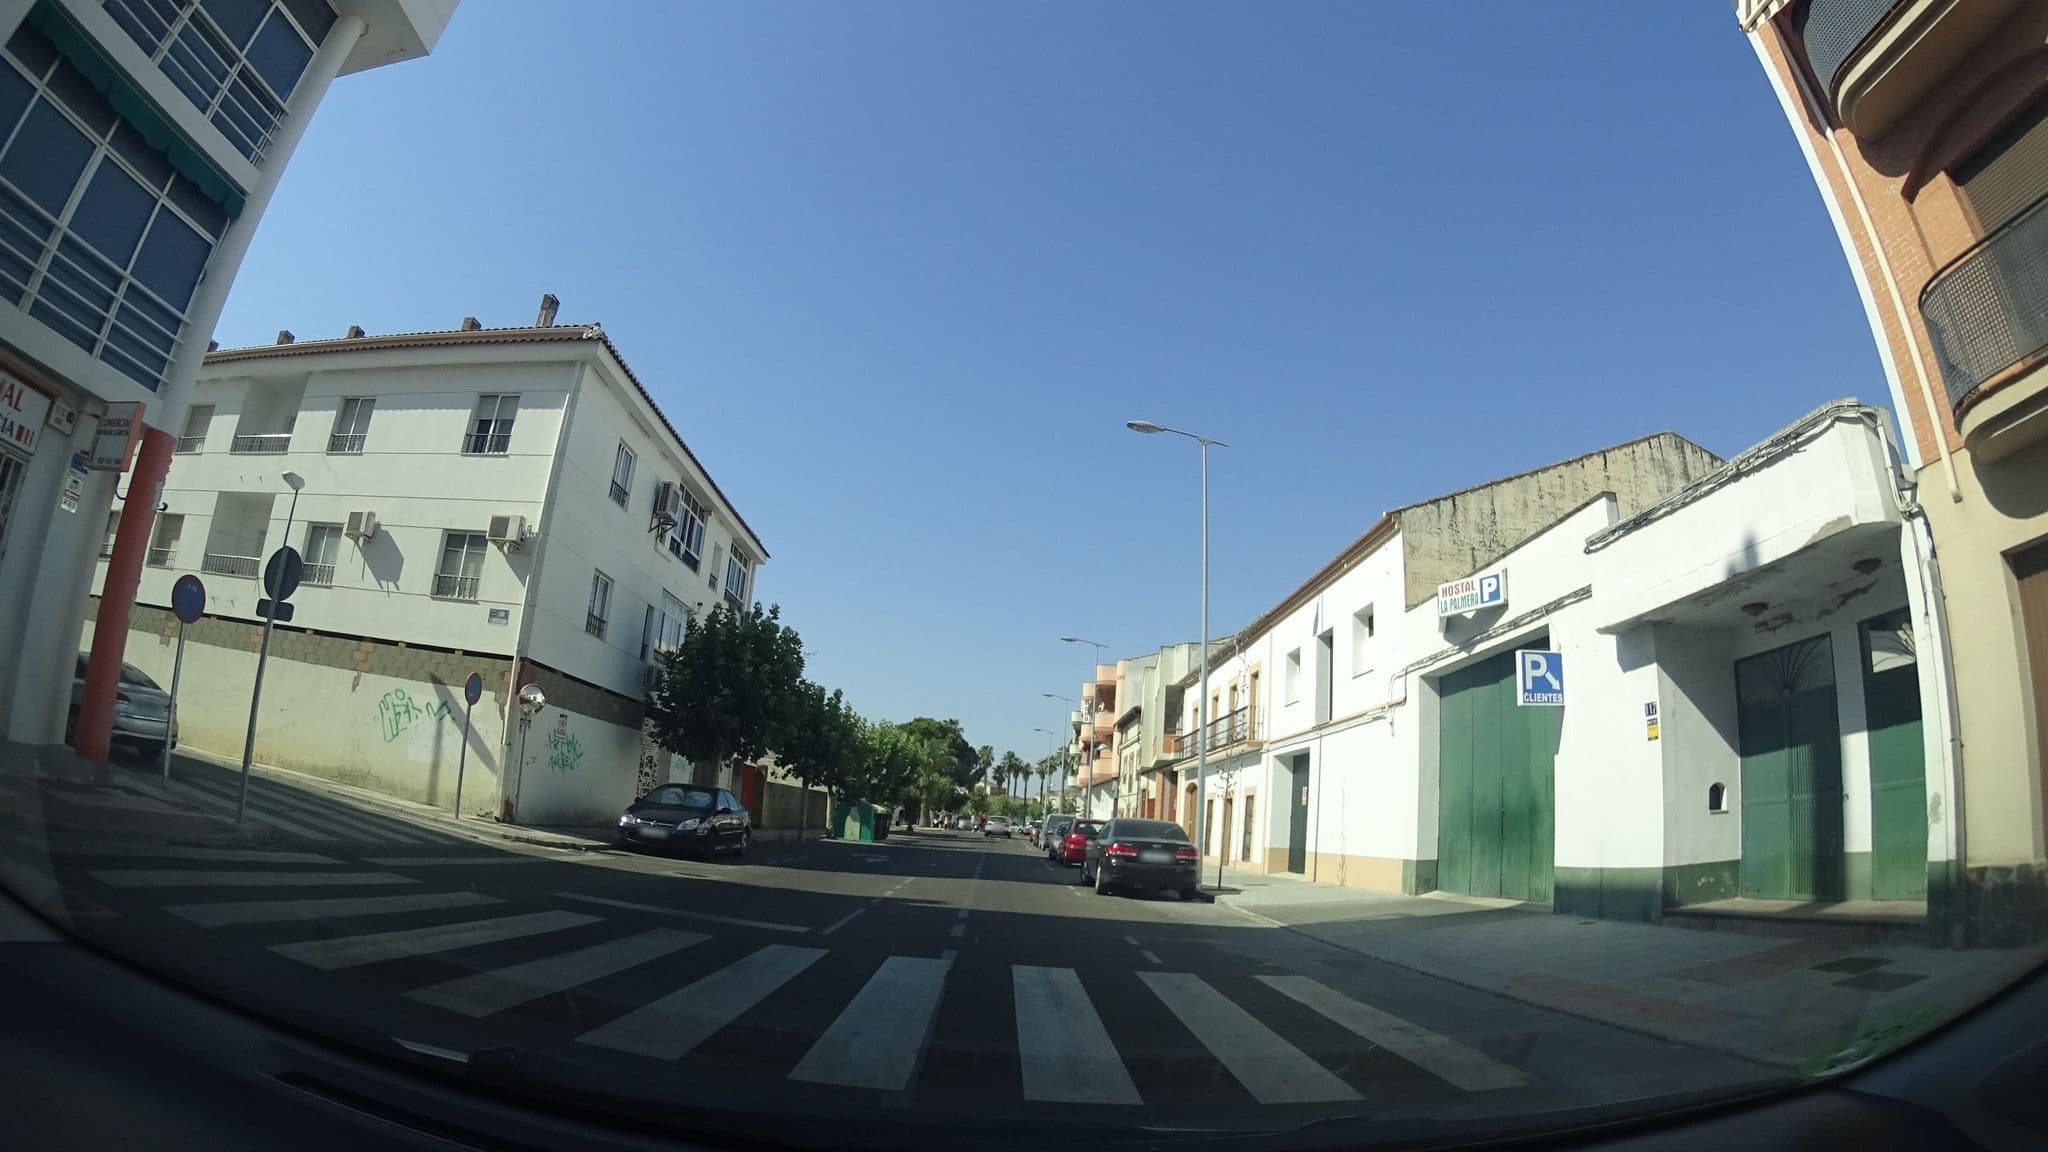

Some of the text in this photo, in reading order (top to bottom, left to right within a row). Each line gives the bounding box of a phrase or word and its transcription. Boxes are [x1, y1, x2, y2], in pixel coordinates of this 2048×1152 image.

[1442, 580, 1476, 598] HOSTAL
[1482, 577, 1497, 601] P
[1440, 592, 1479, 613] LA PALMERA
[1525, 653, 1547, 689] P
[1524, 693, 1563, 703] CLIENTES
